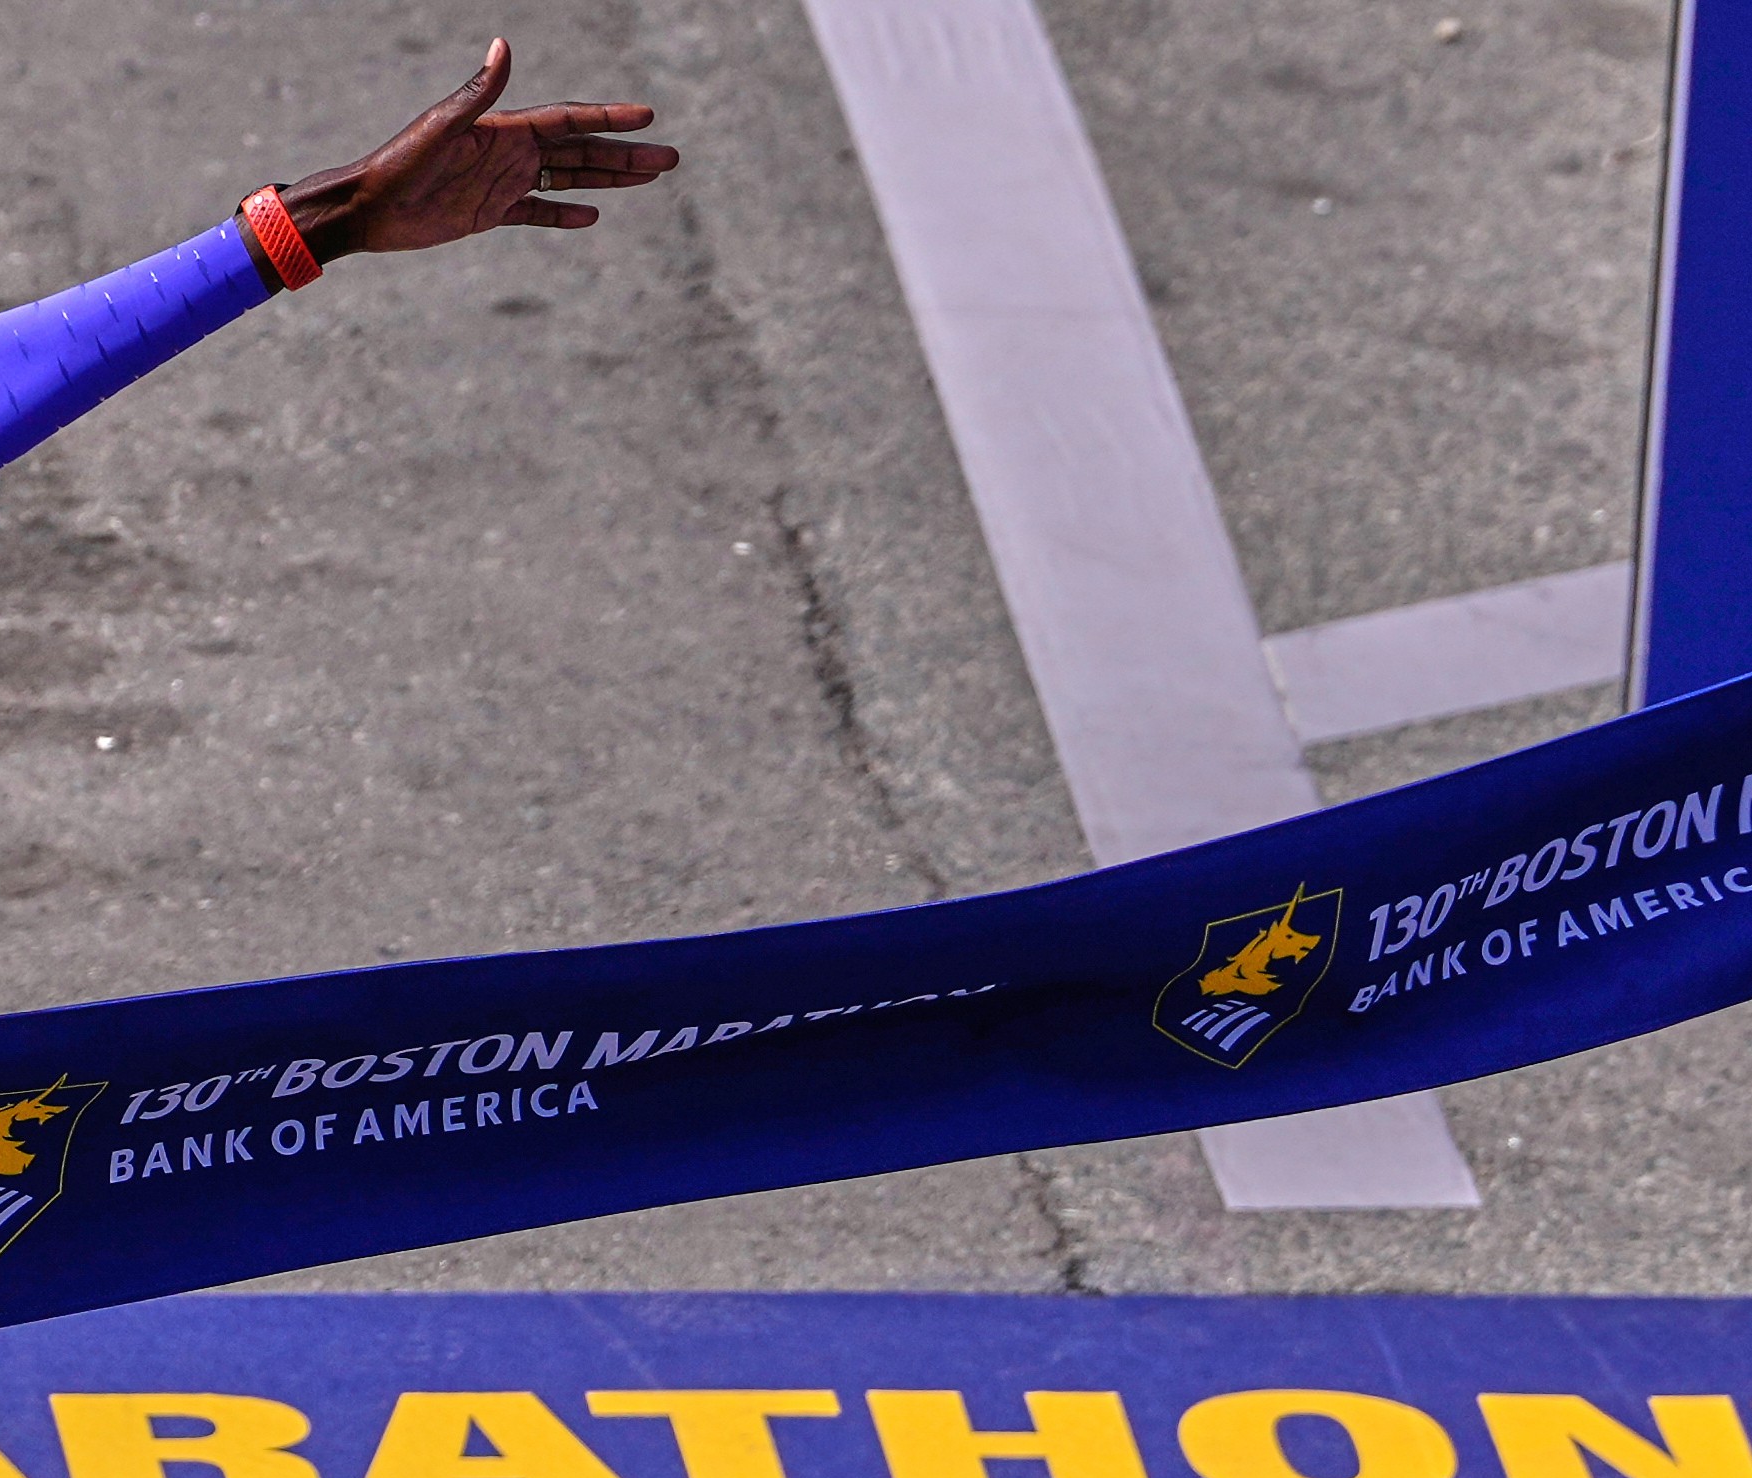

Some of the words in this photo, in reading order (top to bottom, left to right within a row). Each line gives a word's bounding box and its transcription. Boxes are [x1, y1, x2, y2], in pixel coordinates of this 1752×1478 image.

[1367, 866, 1492, 963] 130TH
[1481, 782, 1724, 911] BOSTON
[1346, 939, 1468, 1013] BANK
[1480, 917, 1539, 967] OF
[119, 1063, 278, 1126] 130TH
[270, 1029, 575, 1100] BOSTON
[108, 1125, 255, 1185] BANK
[270, 1112, 339, 1157] OF
[352, 1079, 600, 1146] AMERICA
